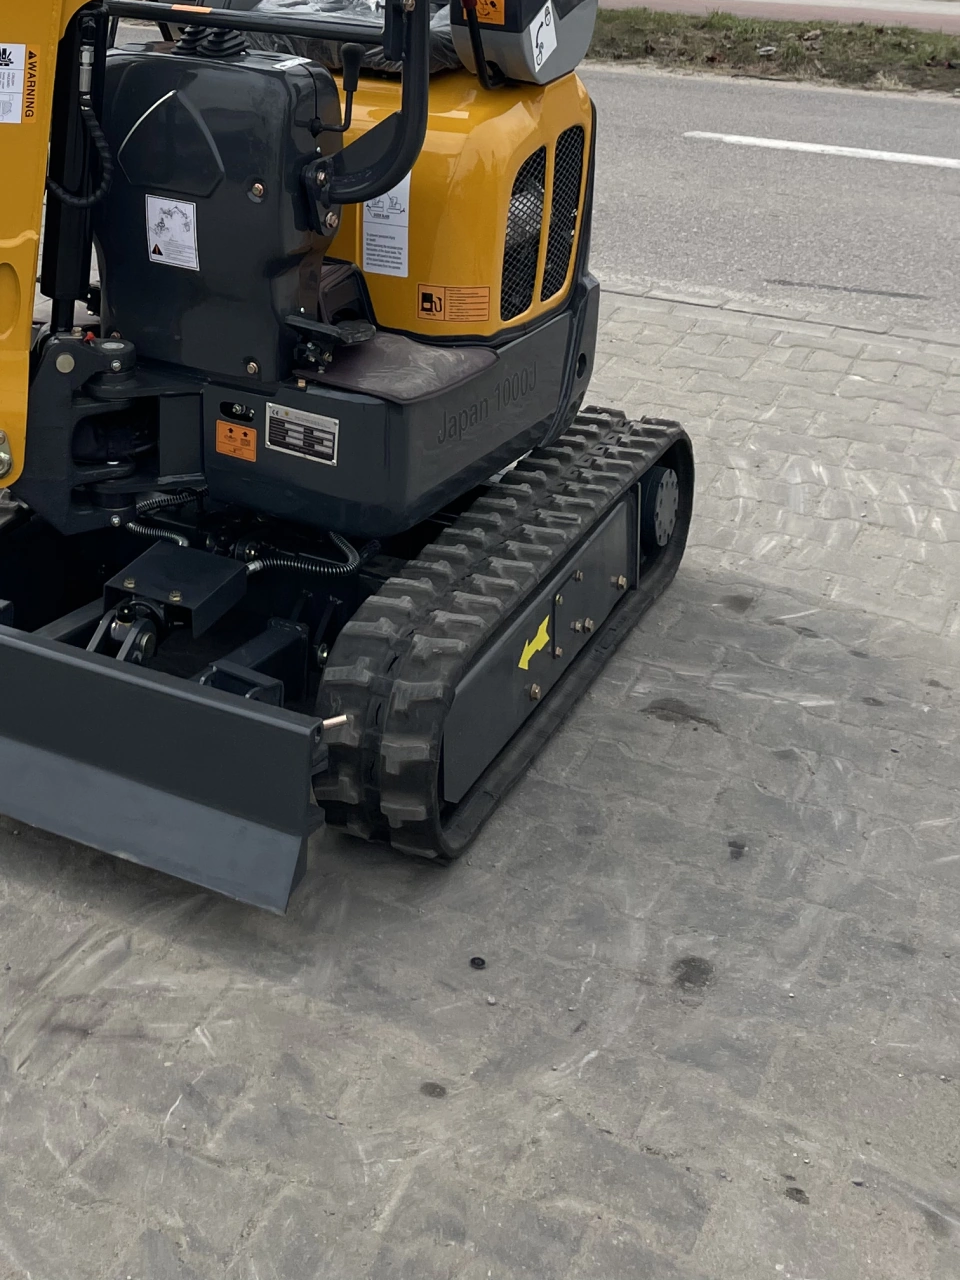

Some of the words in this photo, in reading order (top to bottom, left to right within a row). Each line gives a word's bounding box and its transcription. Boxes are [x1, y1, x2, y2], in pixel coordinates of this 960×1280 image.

[25, 61, 37, 118] WARNING
[437, 397, 489, 445] Japan
[494, 361, 537, 412] 1000J
